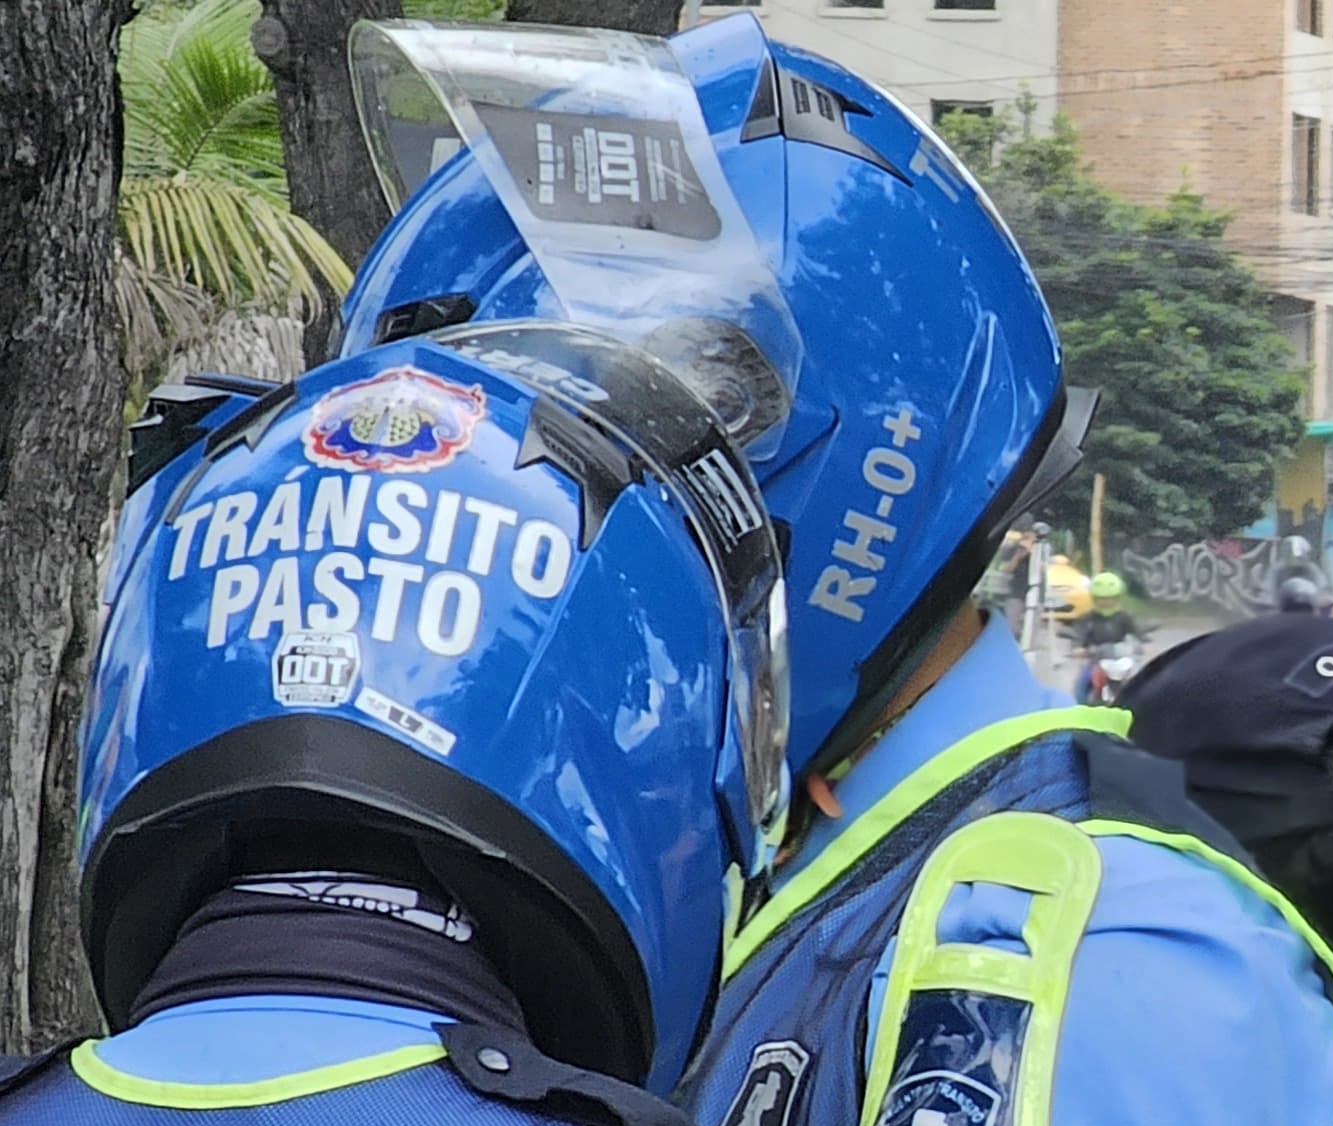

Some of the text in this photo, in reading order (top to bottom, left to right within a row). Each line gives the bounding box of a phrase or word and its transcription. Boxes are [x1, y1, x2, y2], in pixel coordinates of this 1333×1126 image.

[168, 465, 573, 599] TRÁNSITO
[207, 552, 482, 658] PASTO
[281, 654, 349, 686] DOT
